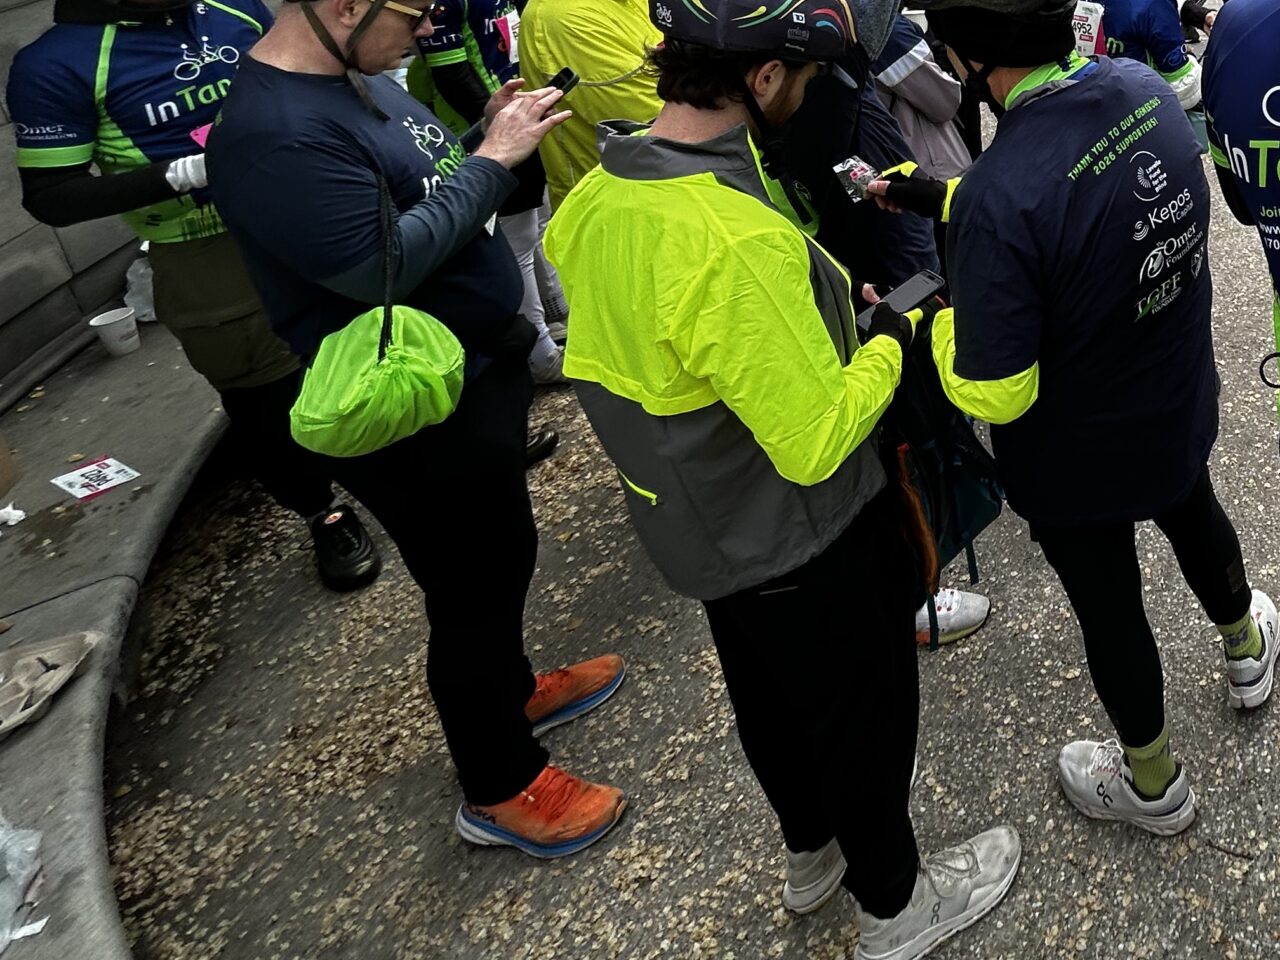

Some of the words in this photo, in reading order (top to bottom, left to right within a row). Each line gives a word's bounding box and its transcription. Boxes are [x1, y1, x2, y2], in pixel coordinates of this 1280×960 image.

[1067, 153, 1094, 181] THANK
[1091, 136, 1109, 155] YOU
[1108, 127, 1120, 140] TO
[1120, 114, 1135, 131] OUR
[1134, 96, 1161, 119] GENEROUS
[1093, 151, 1116, 175] 2026
[1115, 116, 1159, 155] SUPPORTERS!
[1147, 188, 1191, 229] Kepos
[1175, 199, 1194, 220] Capital
[1163, 221, 1197, 256] Omer
[1165, 231, 1204, 268] Foundation
